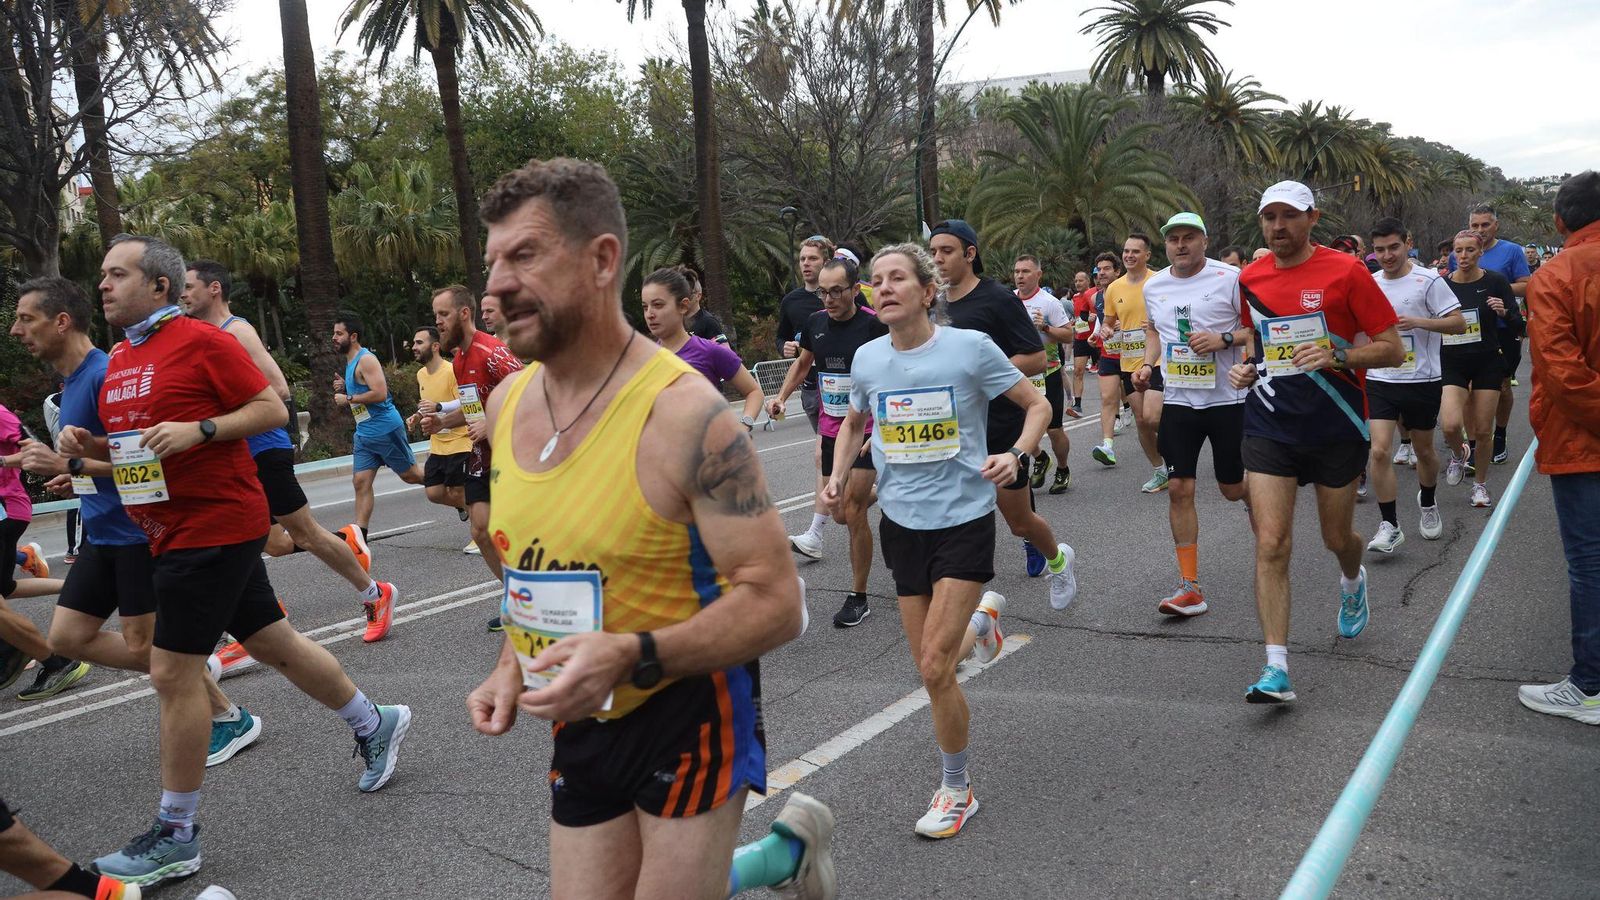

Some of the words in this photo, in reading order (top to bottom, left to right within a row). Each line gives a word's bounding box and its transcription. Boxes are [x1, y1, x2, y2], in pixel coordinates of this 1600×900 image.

[1277, 345, 1297, 360] 23
[1177, 364, 1207, 376] 1945
[106, 385, 137, 404] MÁLAGA
[829, 394, 850, 405] 224
[896, 423, 945, 443] 3146
[117, 465, 151, 485] 1262
